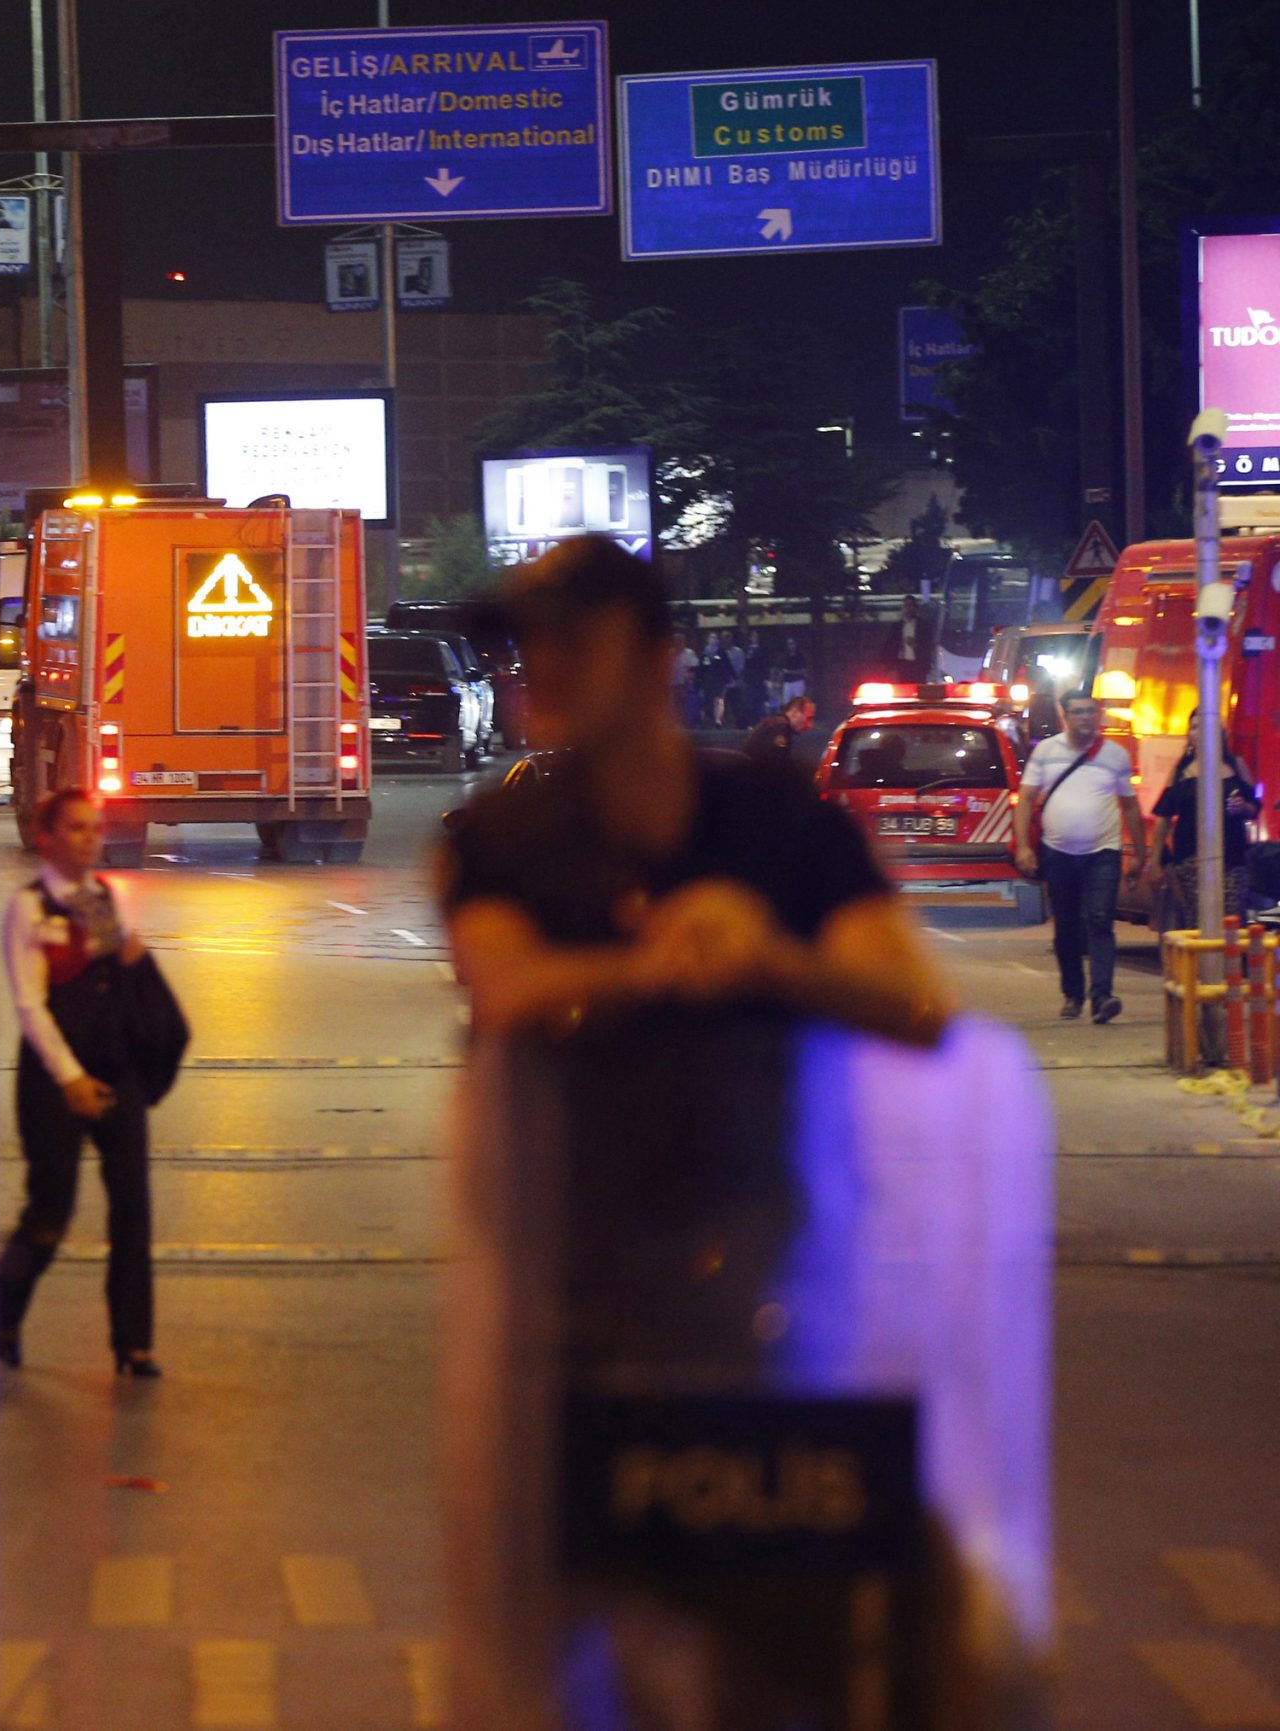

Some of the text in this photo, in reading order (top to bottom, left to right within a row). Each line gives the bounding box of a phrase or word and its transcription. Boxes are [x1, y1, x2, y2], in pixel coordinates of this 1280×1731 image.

[320, 90, 344, 118] İç
[720, 87, 833, 112] Gümrük
[292, 135, 333, 157] Dış
[713, 122, 845, 147] Customs
[1210, 326, 1280, 347] TUDO
